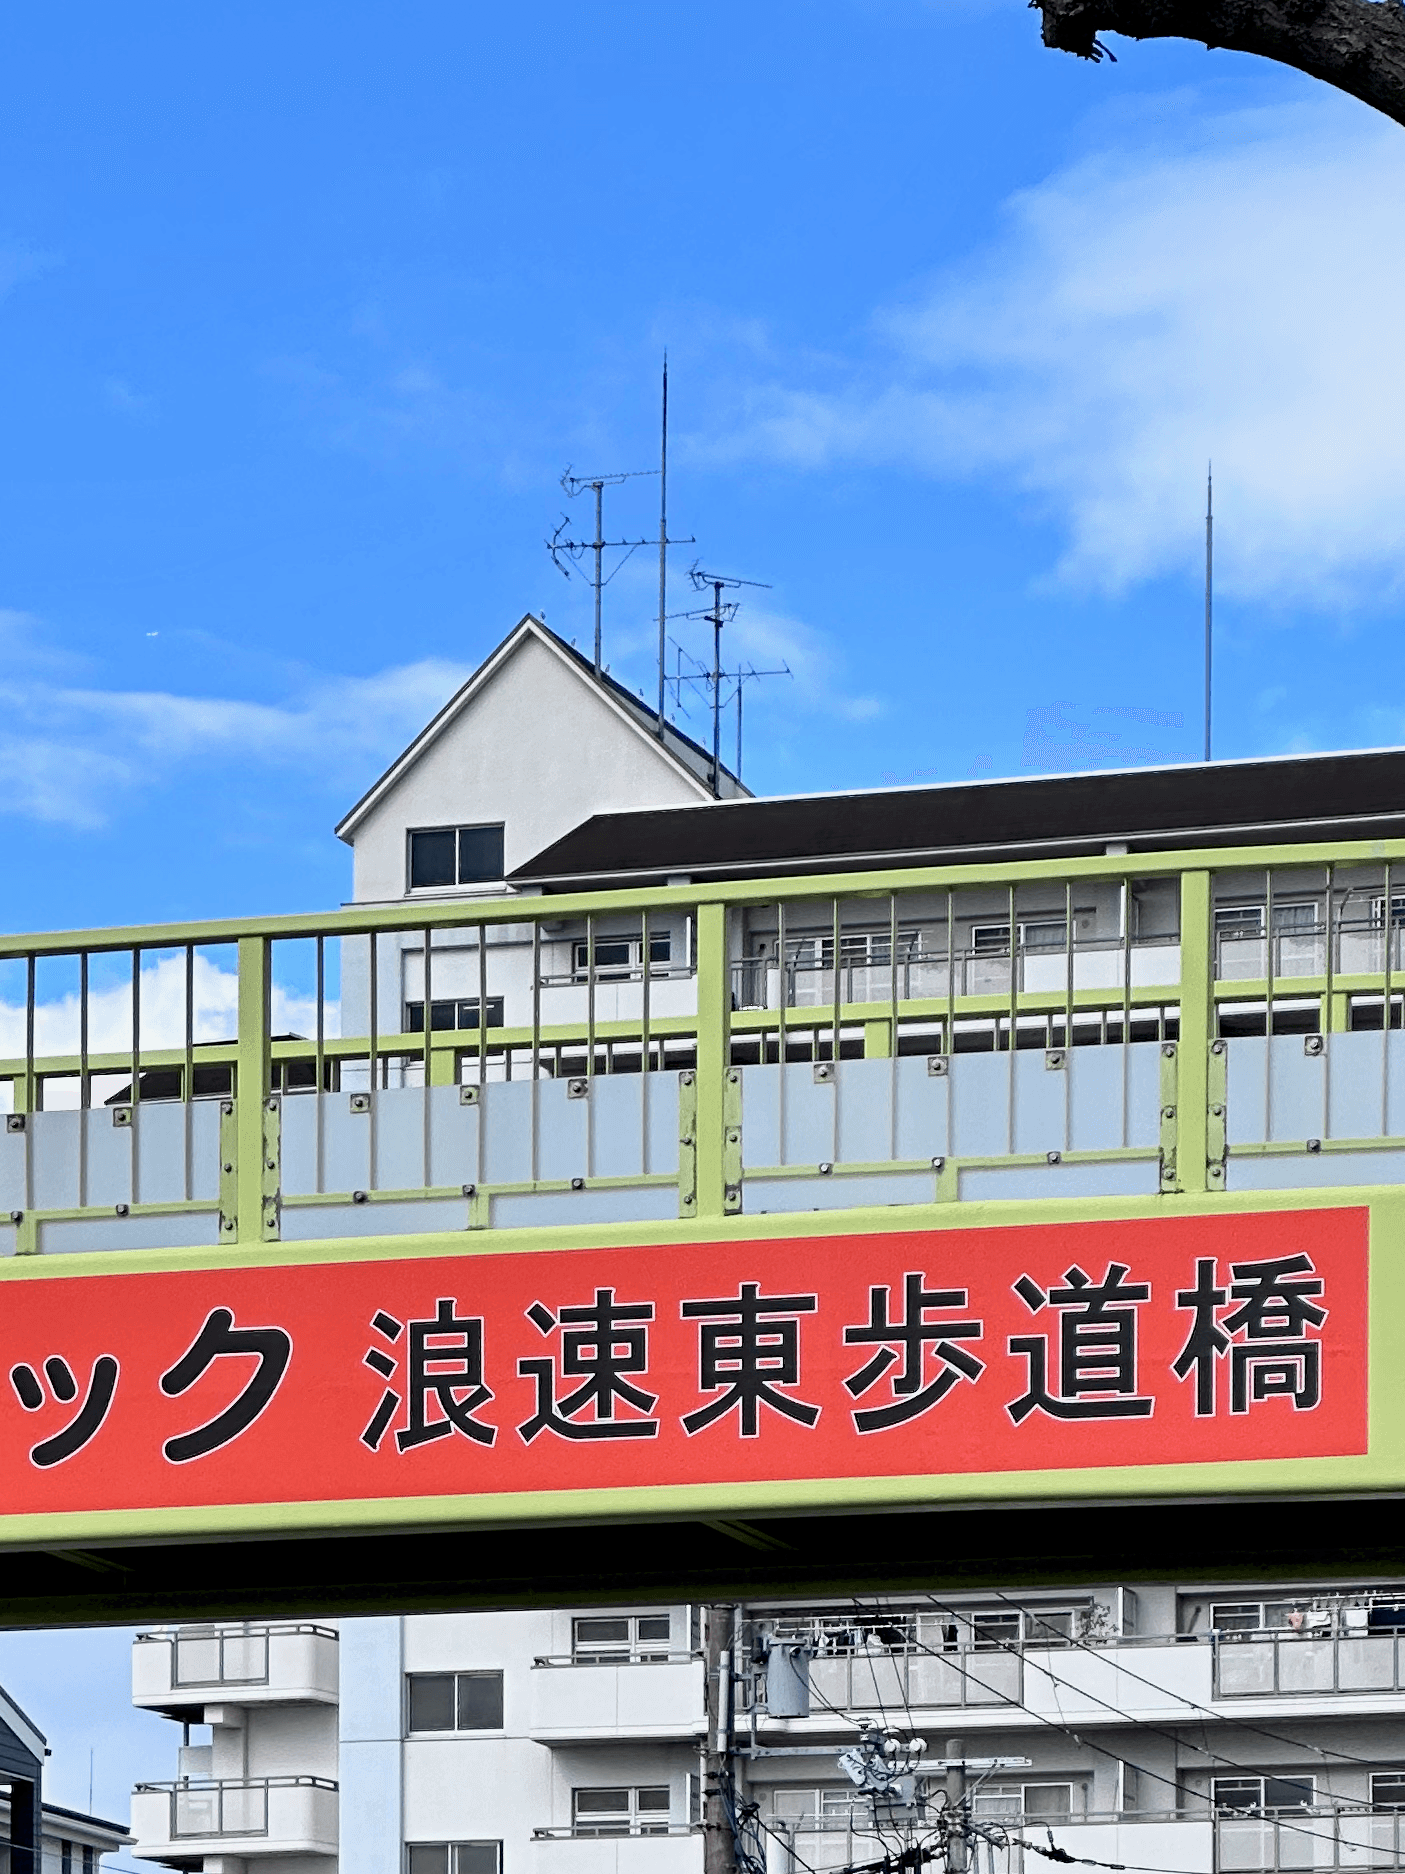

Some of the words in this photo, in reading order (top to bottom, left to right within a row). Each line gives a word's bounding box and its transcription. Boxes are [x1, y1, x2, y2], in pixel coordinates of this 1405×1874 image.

[360, 1252, 1329, 1454] 浪速東歩道橋
